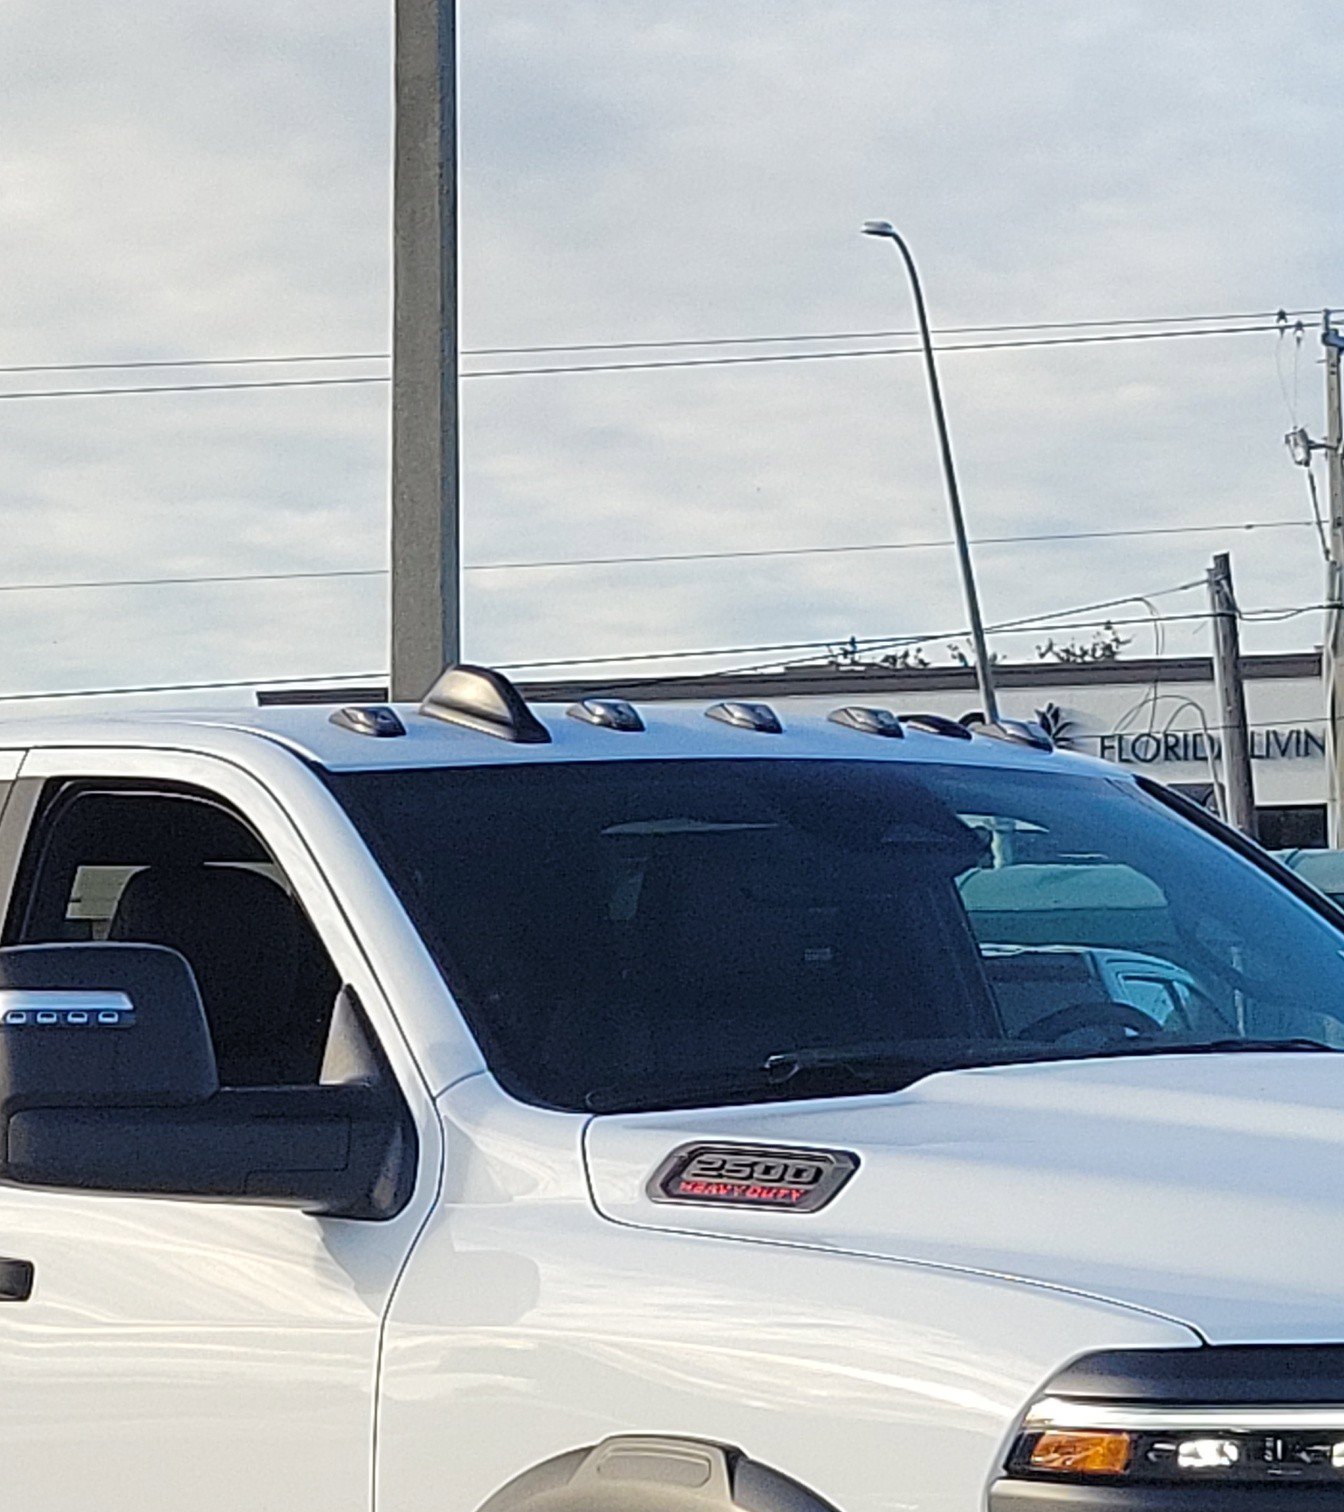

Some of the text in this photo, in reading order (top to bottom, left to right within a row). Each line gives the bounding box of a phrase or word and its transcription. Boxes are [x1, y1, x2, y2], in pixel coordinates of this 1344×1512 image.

[1100, 728, 1344, 763] FLORID LIVIN
[686, 1158, 820, 1185] 2500
[679, 1181, 805, 1203] HEAVY DUTY
